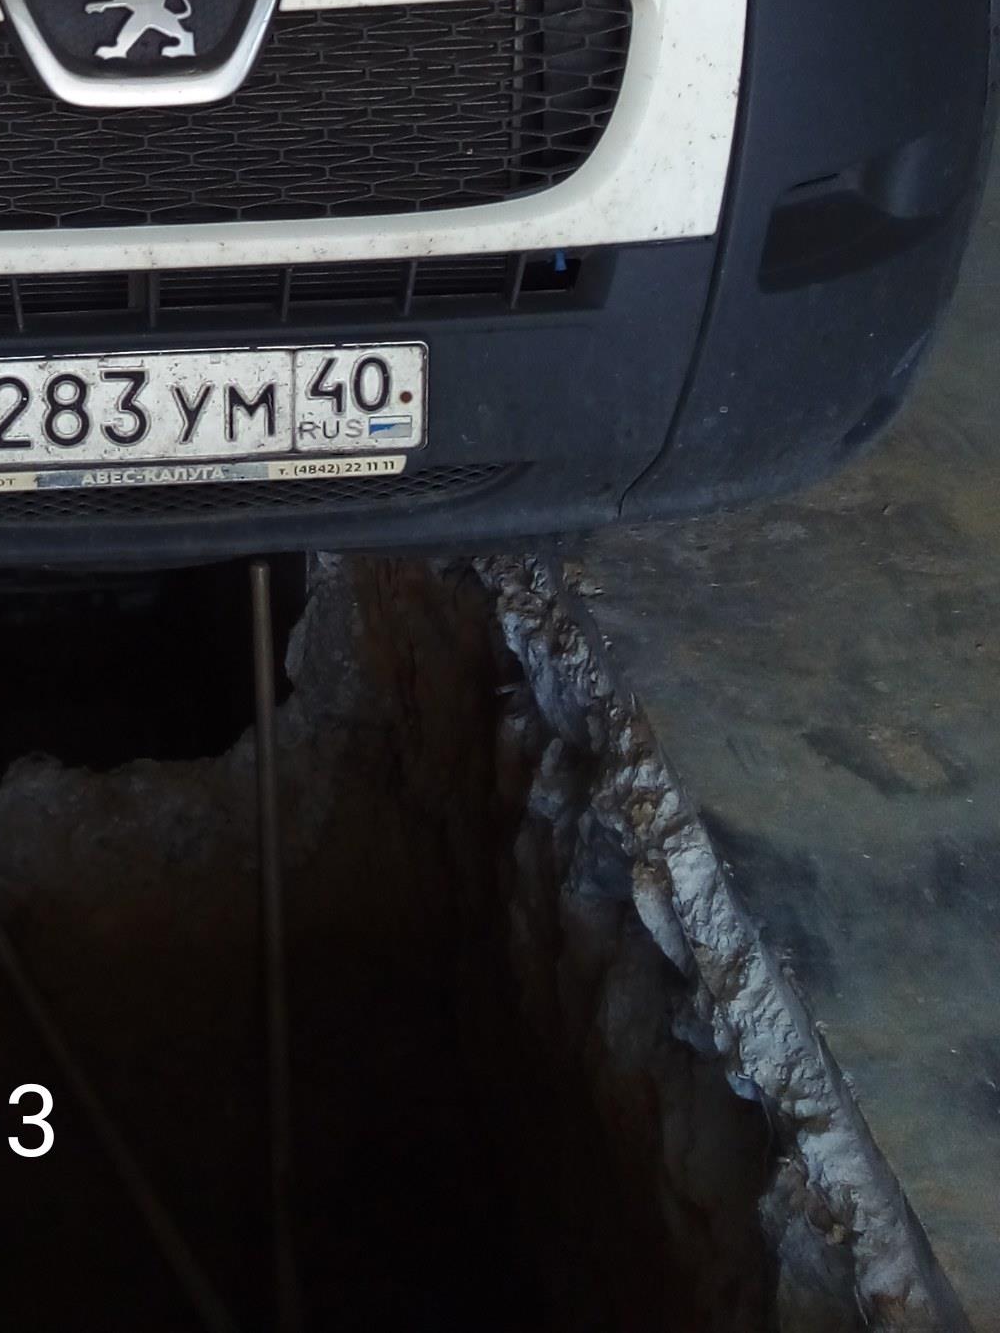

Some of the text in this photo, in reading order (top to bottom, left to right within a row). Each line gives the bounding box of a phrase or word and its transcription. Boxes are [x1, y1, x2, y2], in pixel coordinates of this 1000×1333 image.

[305, 353, 393, 415] 40
[298, 418, 364, 441] RUS
[80, 466, 227, 486] АВЕС-КАЛУГА
[293, 462, 341, 476] (4842)
[344, 461, 362, 473] 22
[366, 461, 379, 472] 11
[382, 460, 395, 471] 11
